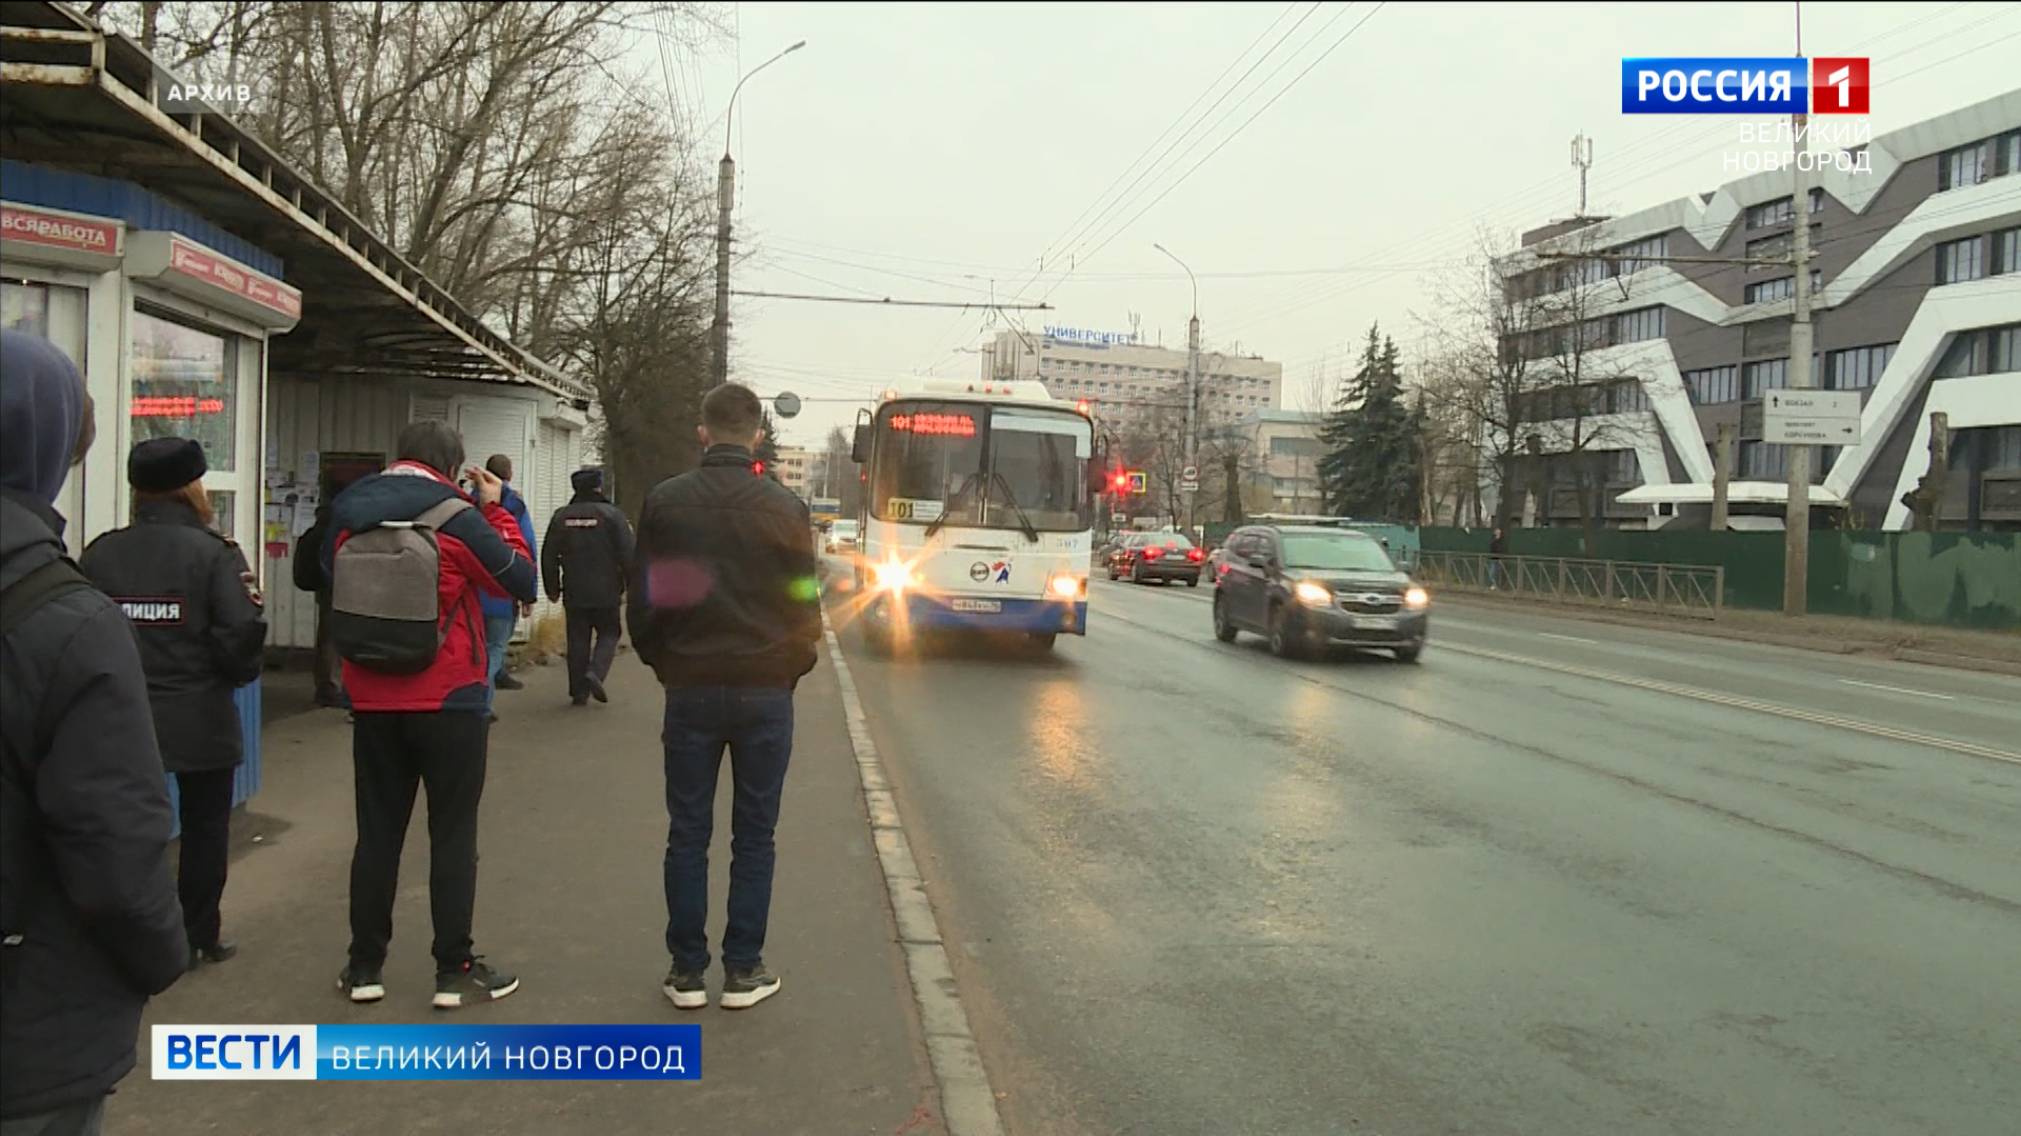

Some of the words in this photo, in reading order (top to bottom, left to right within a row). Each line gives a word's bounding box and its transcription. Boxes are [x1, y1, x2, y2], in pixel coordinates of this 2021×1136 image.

[1, 215, 107, 244] ВСЯРАБОТА
[890, 501, 914, 519] 101
[121, 602, 181, 621] ЛИЦИЯ
